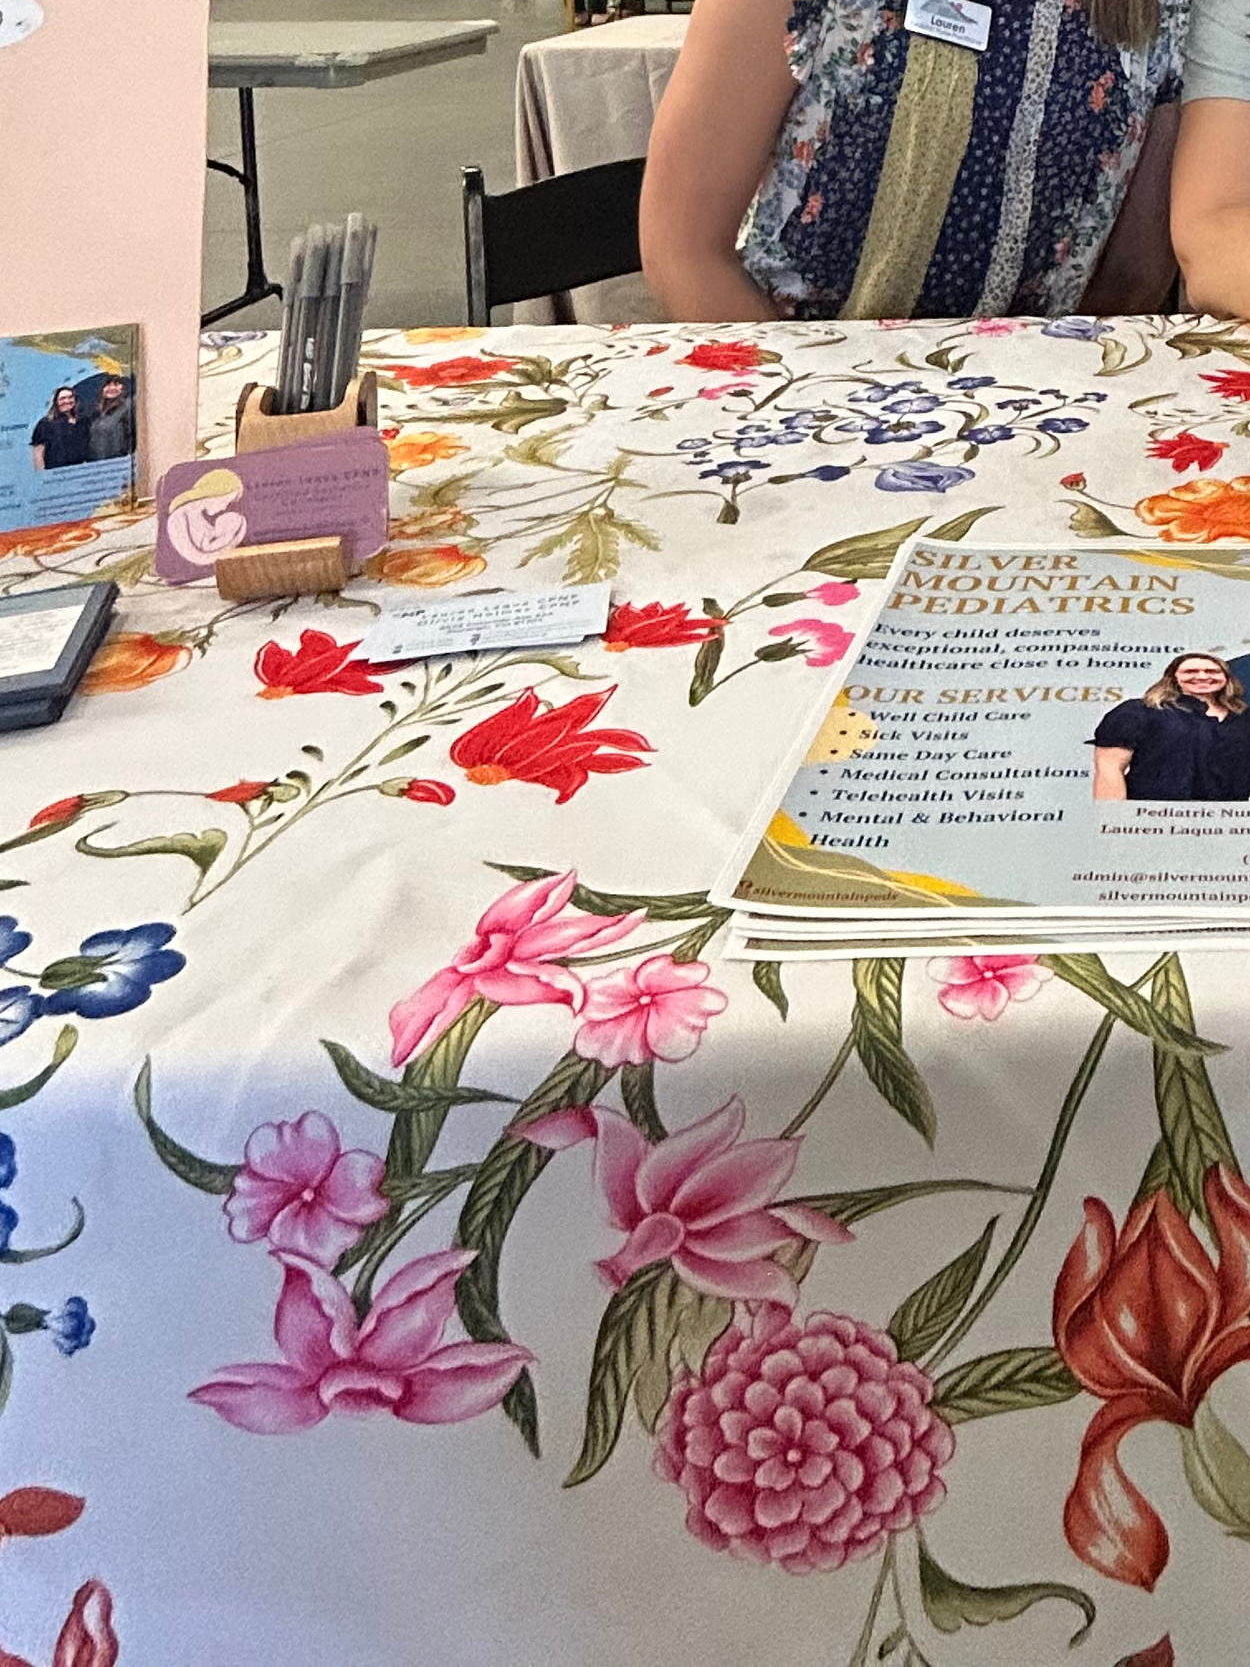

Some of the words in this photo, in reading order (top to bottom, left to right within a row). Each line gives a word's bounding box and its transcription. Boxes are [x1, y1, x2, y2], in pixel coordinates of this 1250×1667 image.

[931, 15, 966, 33] Lauren
[910, 550, 1078, 571] SILVER
[902, 570, 1181, 592] MOUNTAIN
[888, 593, 1196, 616] PEDIATRICS
[874, 623, 935, 640] Every
[942, 624, 999, 639] child
[1005, 626, 1101, 638] deserves
[865, 639, 1005, 655] exceptional,
[1013, 642, 1185, 655] compassionate
[857, 653, 983, 671] healthcare
[990, 656, 1052, 670] close
[1057, 657, 1081, 669] to
[1086, 657, 1152, 670] home
[843, 684, 924, 704] OUR
[936, 686, 1124, 705] SERVICES
[869, 711, 917, 722] Well
[922, 711, 978, 722] Child
[984, 711, 1031, 721] Care
[858, 729, 902, 741] Sick
[911, 729, 969, 741] Visits
[849, 748, 909, 761] Same
[915, 749, 956, 763] Day
[962, 748, 1013, 761] Care
[839, 767, 928, 781] Medical
[935, 766, 1090, 781] Consultations
[832, 788, 953, 802] Telehealth
[963, 788, 1025, 801] Visits
[820, 809, 904, 824] Mental
[911, 811, 930, 824] &
[938, 808, 1065, 824] Behavioral
[1136, 806, 1215, 818] Pediatric
[1100, 824, 1164, 835] Lauren
[1170, 823, 1224, 837] Laqua
[809, 834, 889, 848] Health
[752, 887, 900, 904] silvermountainpeds
